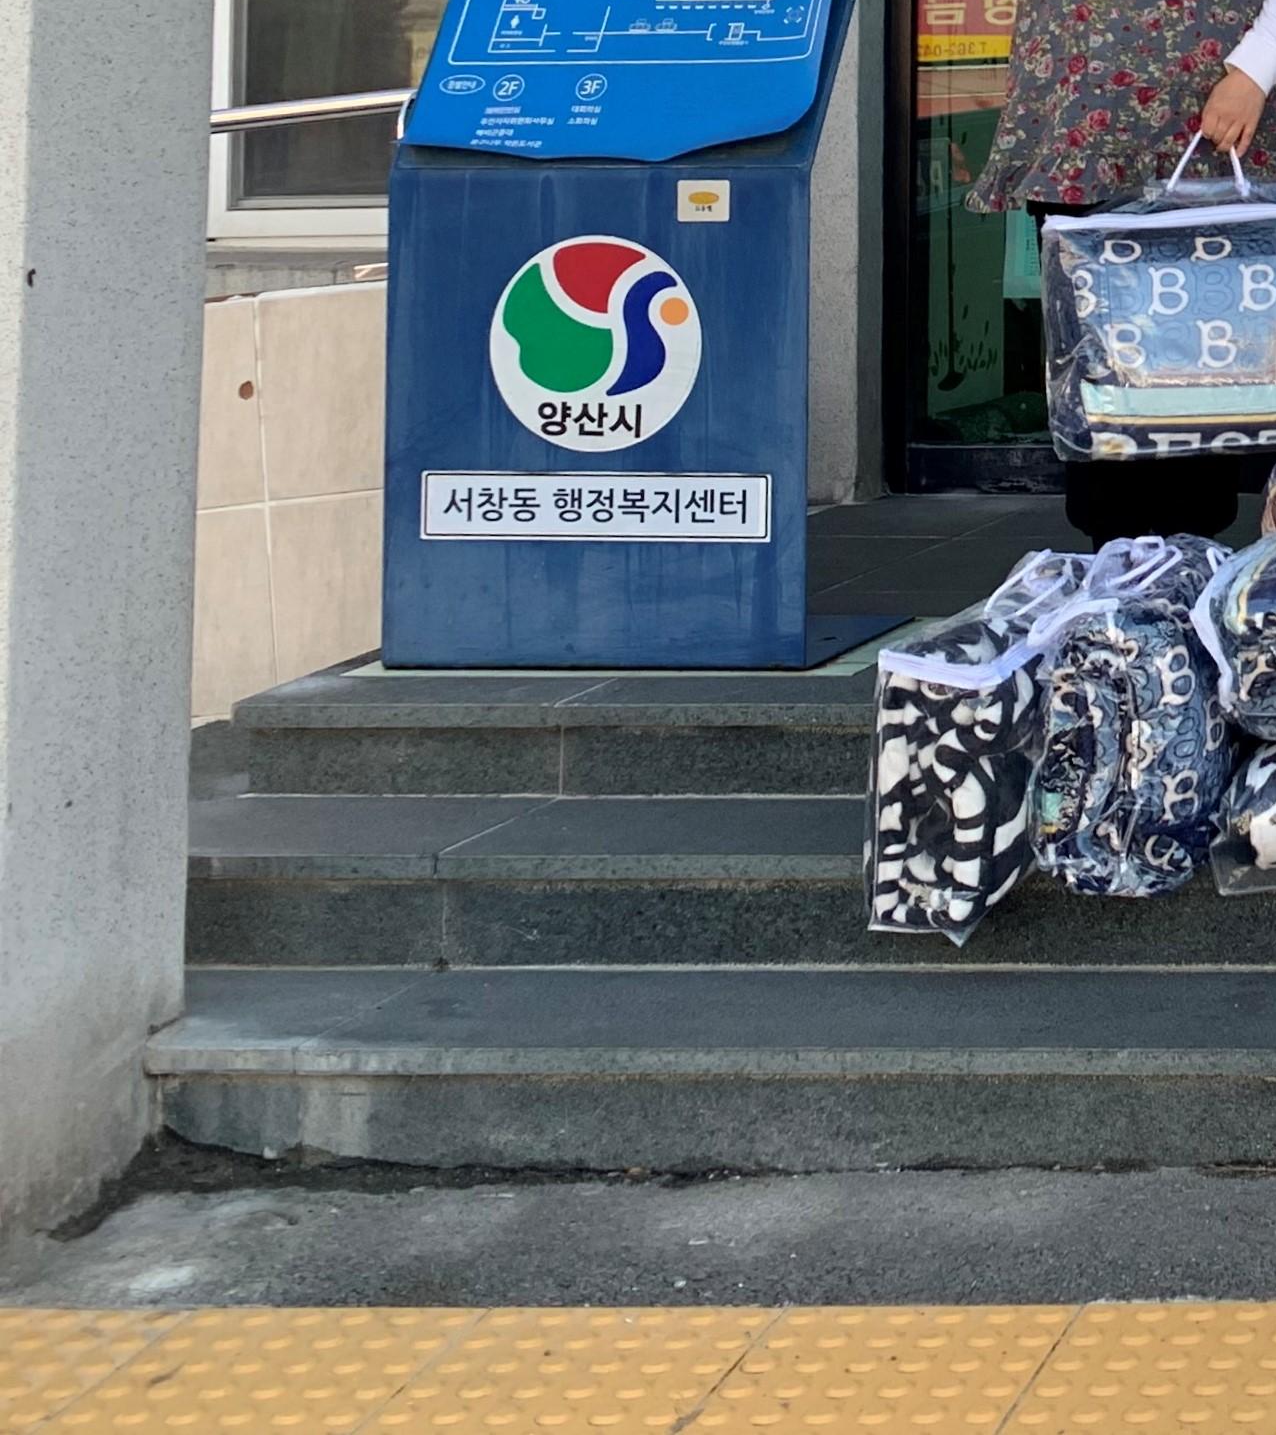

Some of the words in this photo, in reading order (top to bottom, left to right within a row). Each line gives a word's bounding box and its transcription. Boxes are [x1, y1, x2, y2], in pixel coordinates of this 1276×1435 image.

[497, 80, 520, 96] 2F
[579, 80, 603, 96] 3F
[1148, 266, 1189, 315] B
[1196, 319, 1238, 368] B
[536, 400, 644, 440] 양산시
[441, 486, 542, 525] 서창동
[552, 484, 751, 527] 행정복지센터
